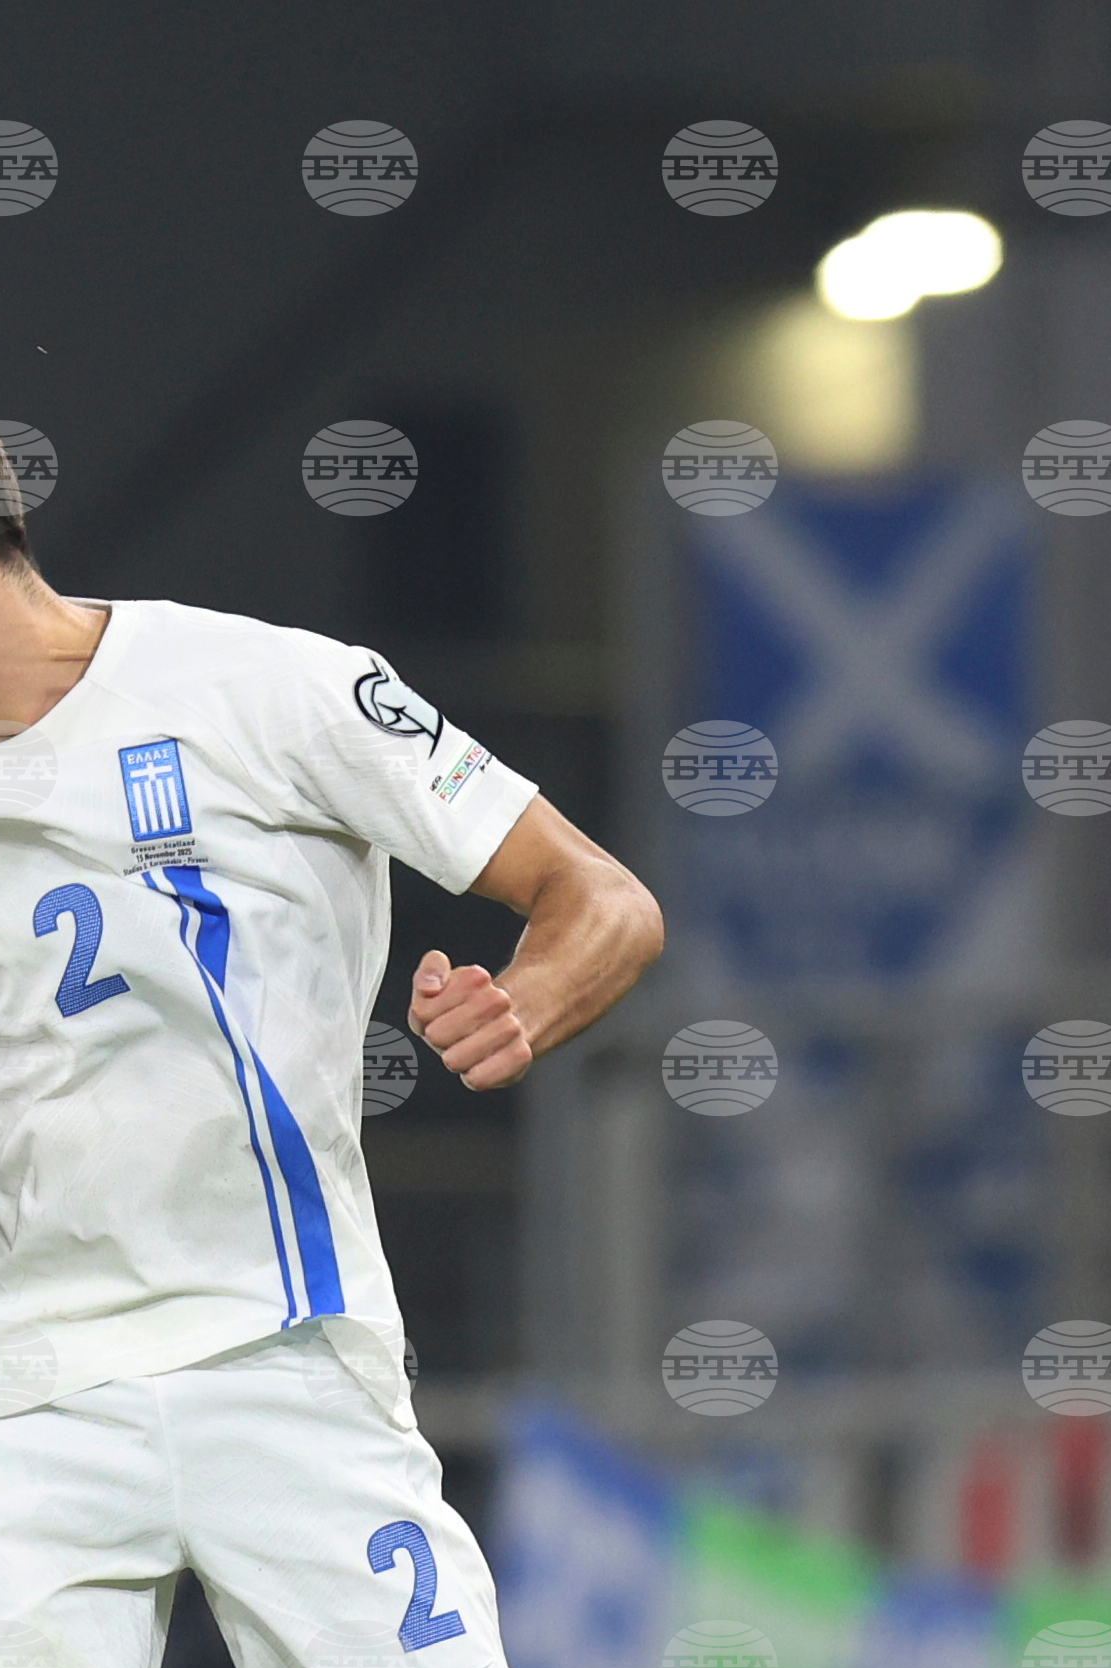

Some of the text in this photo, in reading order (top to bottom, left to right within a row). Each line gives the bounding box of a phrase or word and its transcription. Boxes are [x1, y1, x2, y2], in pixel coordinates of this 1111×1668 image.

[126, 749, 170, 765] ΕΛΛΑΣ
[439, 745, 483, 802] FOUNDATIO
[131, 845, 156, 854] Greece
[163, 839, 196, 849] Scotland
[136, 848, 192, 863] 15 November 2025
[32, 882, 132, 1018] 2
[366, 1520, 467, 1653] 2
